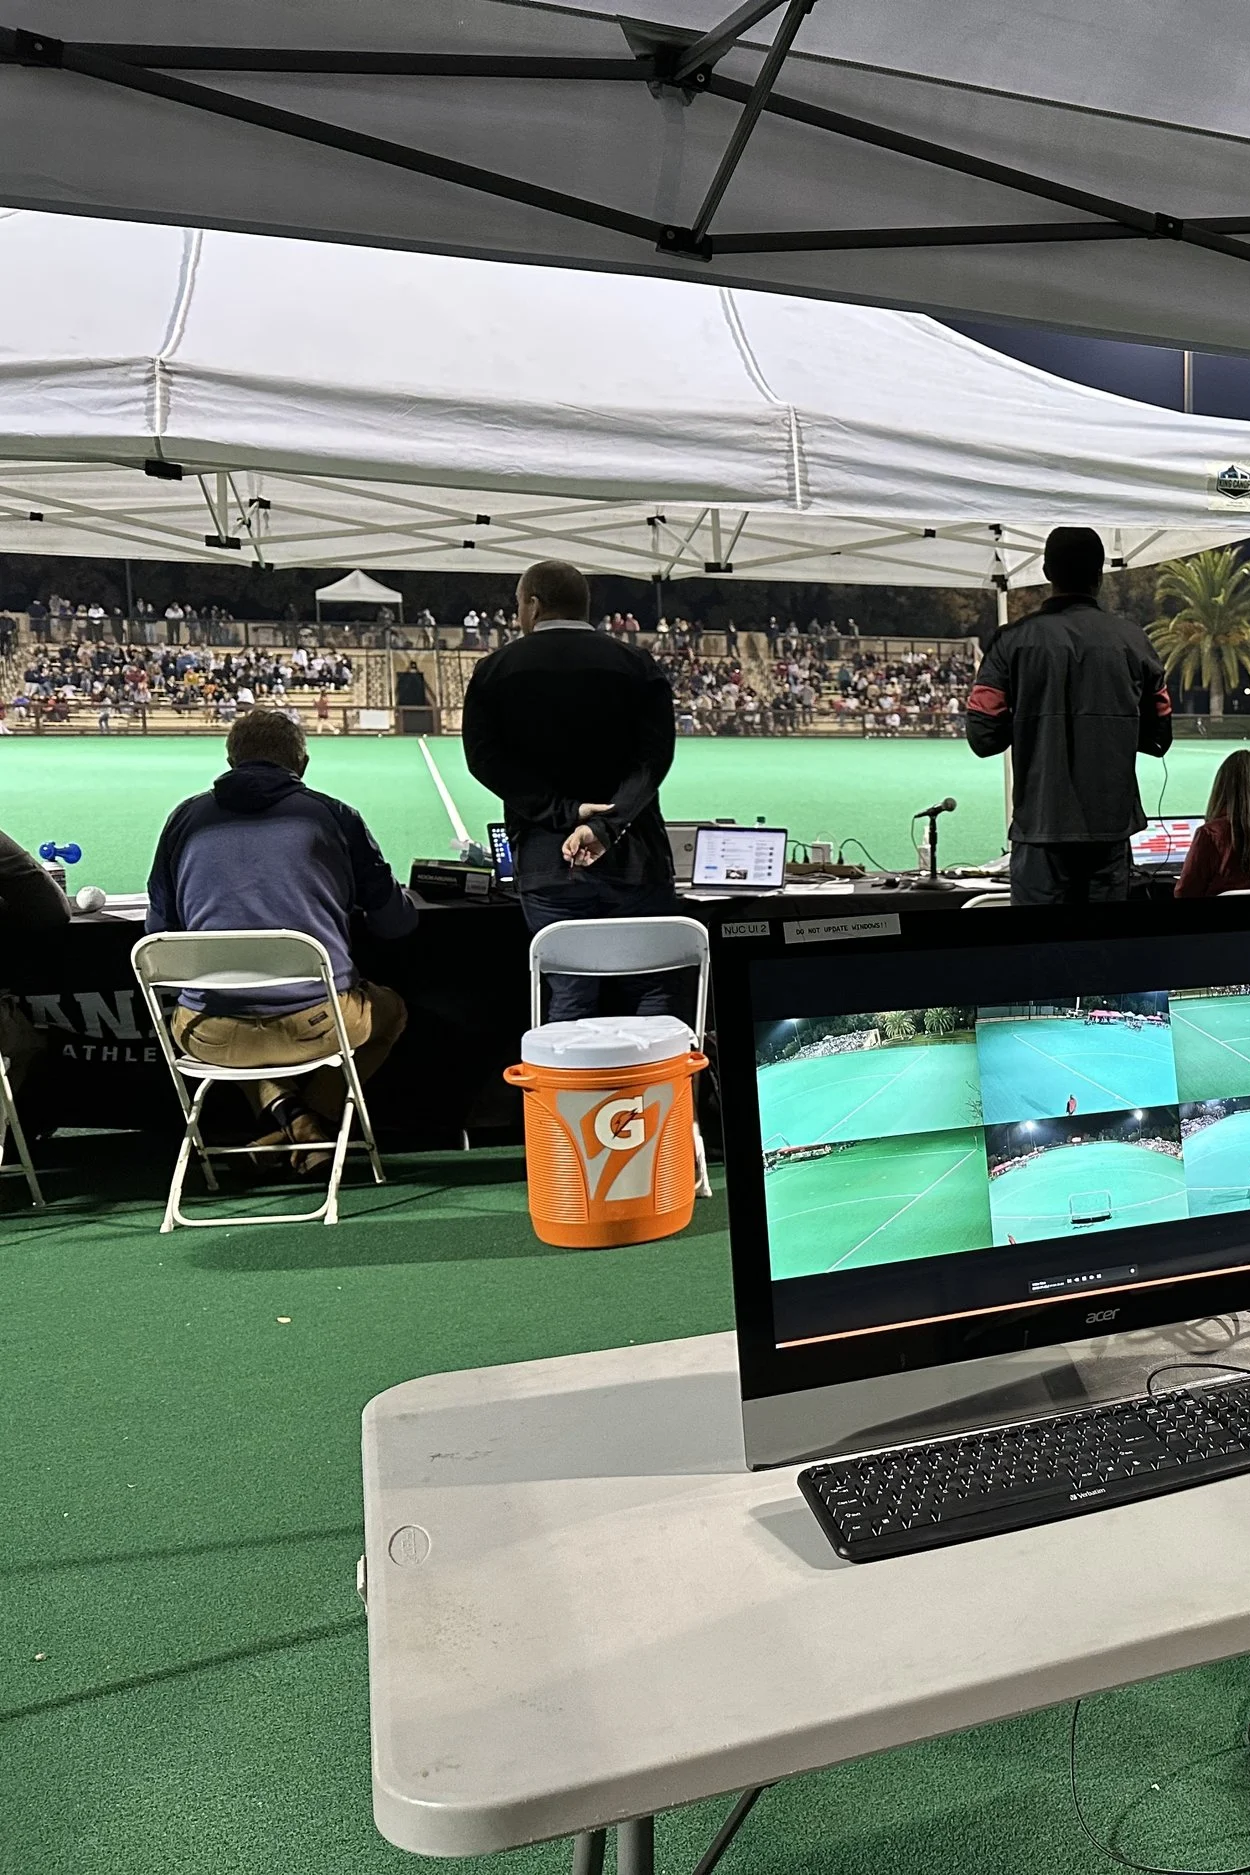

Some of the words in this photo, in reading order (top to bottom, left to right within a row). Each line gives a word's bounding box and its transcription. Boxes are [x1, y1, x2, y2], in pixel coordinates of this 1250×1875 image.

[724, 925, 746, 935] NUC
[760, 925, 767, 933] 2
[796, 928, 804, 936] DO
[823, 925, 848, 933] UPDATE
[851, 921, 888, 931] WINDOWS!!
[594, 1095, 645, 1151] G
[1085, 1308, 1121, 1324] acer
[1076, 1488, 1106, 1499] Verbatim
